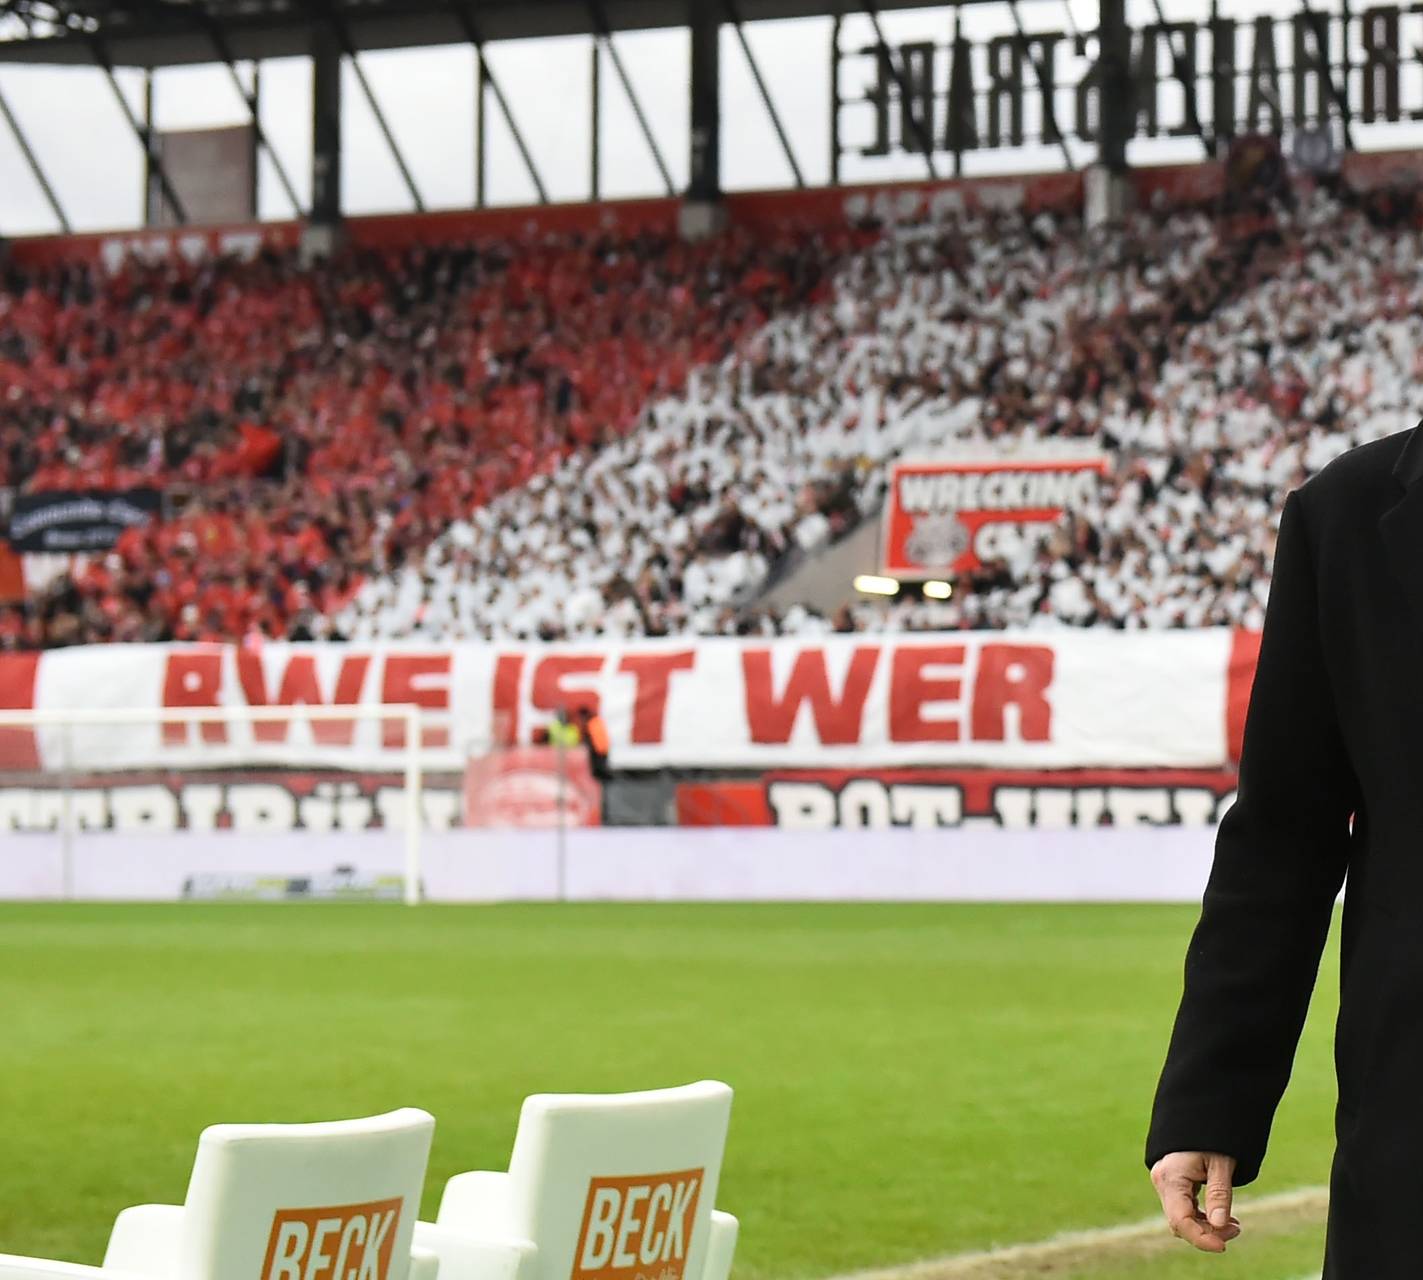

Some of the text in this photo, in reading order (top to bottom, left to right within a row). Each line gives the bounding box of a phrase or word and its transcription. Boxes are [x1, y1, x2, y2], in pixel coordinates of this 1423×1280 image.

[159, 642, 1056, 748] RWE IST WER
[268, 1208, 396, 1280] BECK
[580, 1178, 699, 1271] BECK
